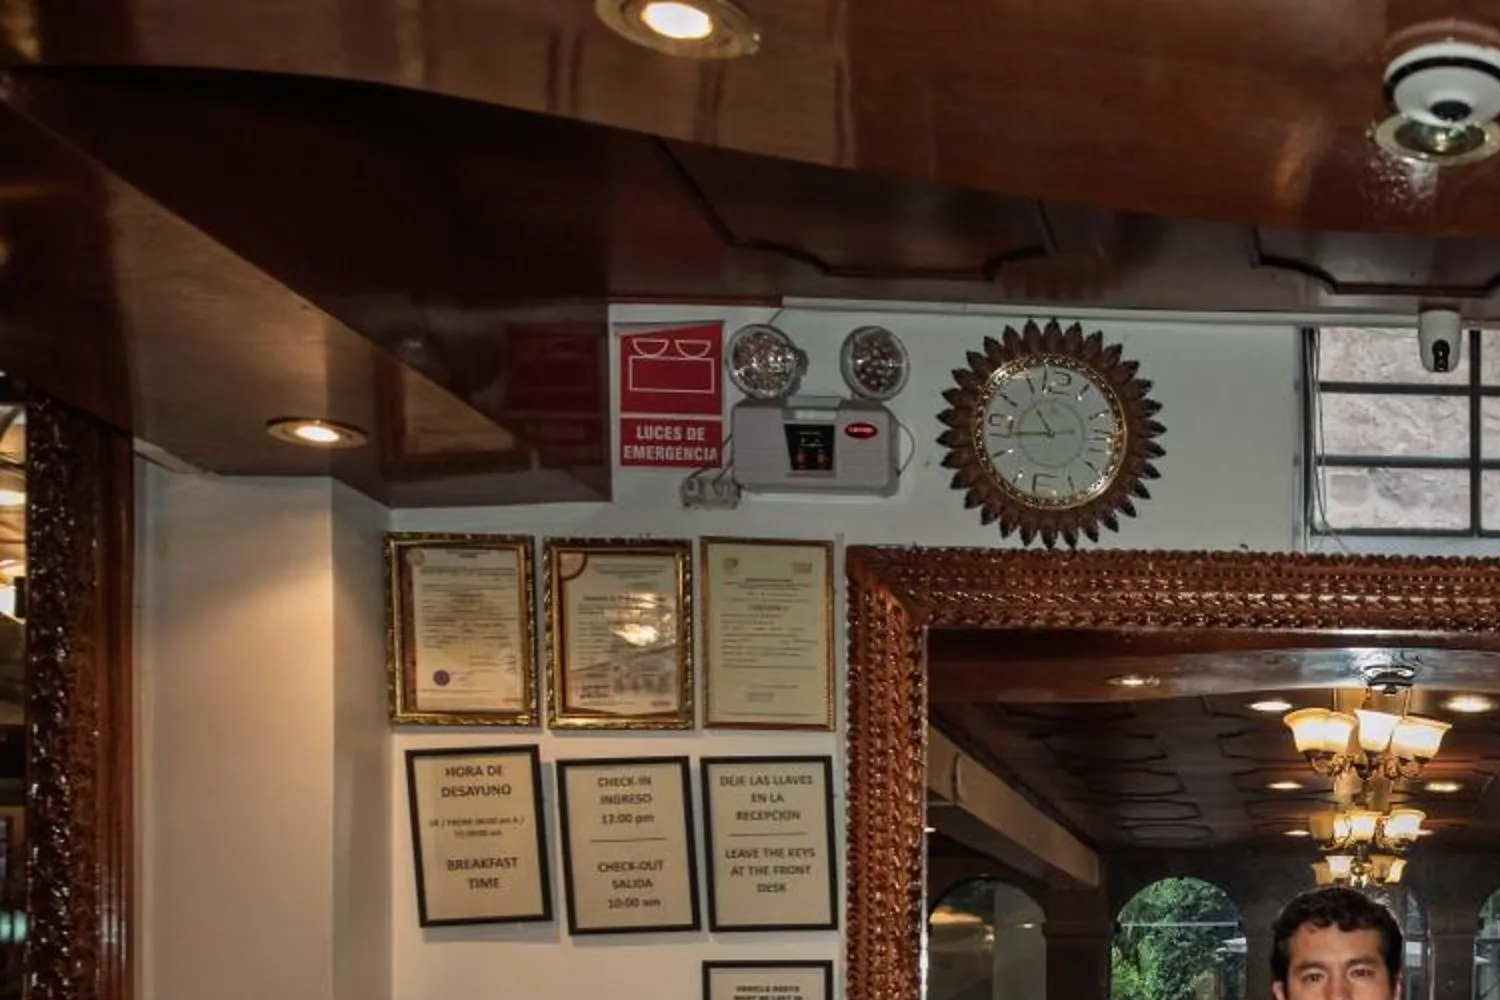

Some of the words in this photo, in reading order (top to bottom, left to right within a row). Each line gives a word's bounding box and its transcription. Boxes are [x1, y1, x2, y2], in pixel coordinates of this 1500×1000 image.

[636, 424, 680, 441] LUCES
[686, 425, 705, 441] DE
[622, 445, 718, 462] EMERGENCIA
[445, 765, 483, 779] HORA
[487, 764, 503, 777] DE
[597, 776, 652, 788] CHECK-IN
[720, 775, 745, 787] DEJE
[750, 775, 770, 786] LAS
[773, 775, 813, 785] LLAVES
[441, 783, 513, 798] DESAYUNO
[600, 793, 653, 805] INGRESO
[751, 792, 767, 804] EN
[770, 792, 785, 803] LA
[635, 814, 655, 827] pm
[725, 848, 759, 859] LEAVE
[764, 848, 785, 859] THE
[788, 847, 816, 859] KEYS
[446, 856, 519, 871] BREAKFAST
[597, 860, 665, 873] CHECK-OUT
[730, 865, 746, 877] AT
[749, 865, 769, 876] THE
[773, 864, 812, 875] FRONT
[468, 876, 500, 890] TIME
[611, 878, 654, 890] SALIDA
[756, 882, 787, 893] DESK
